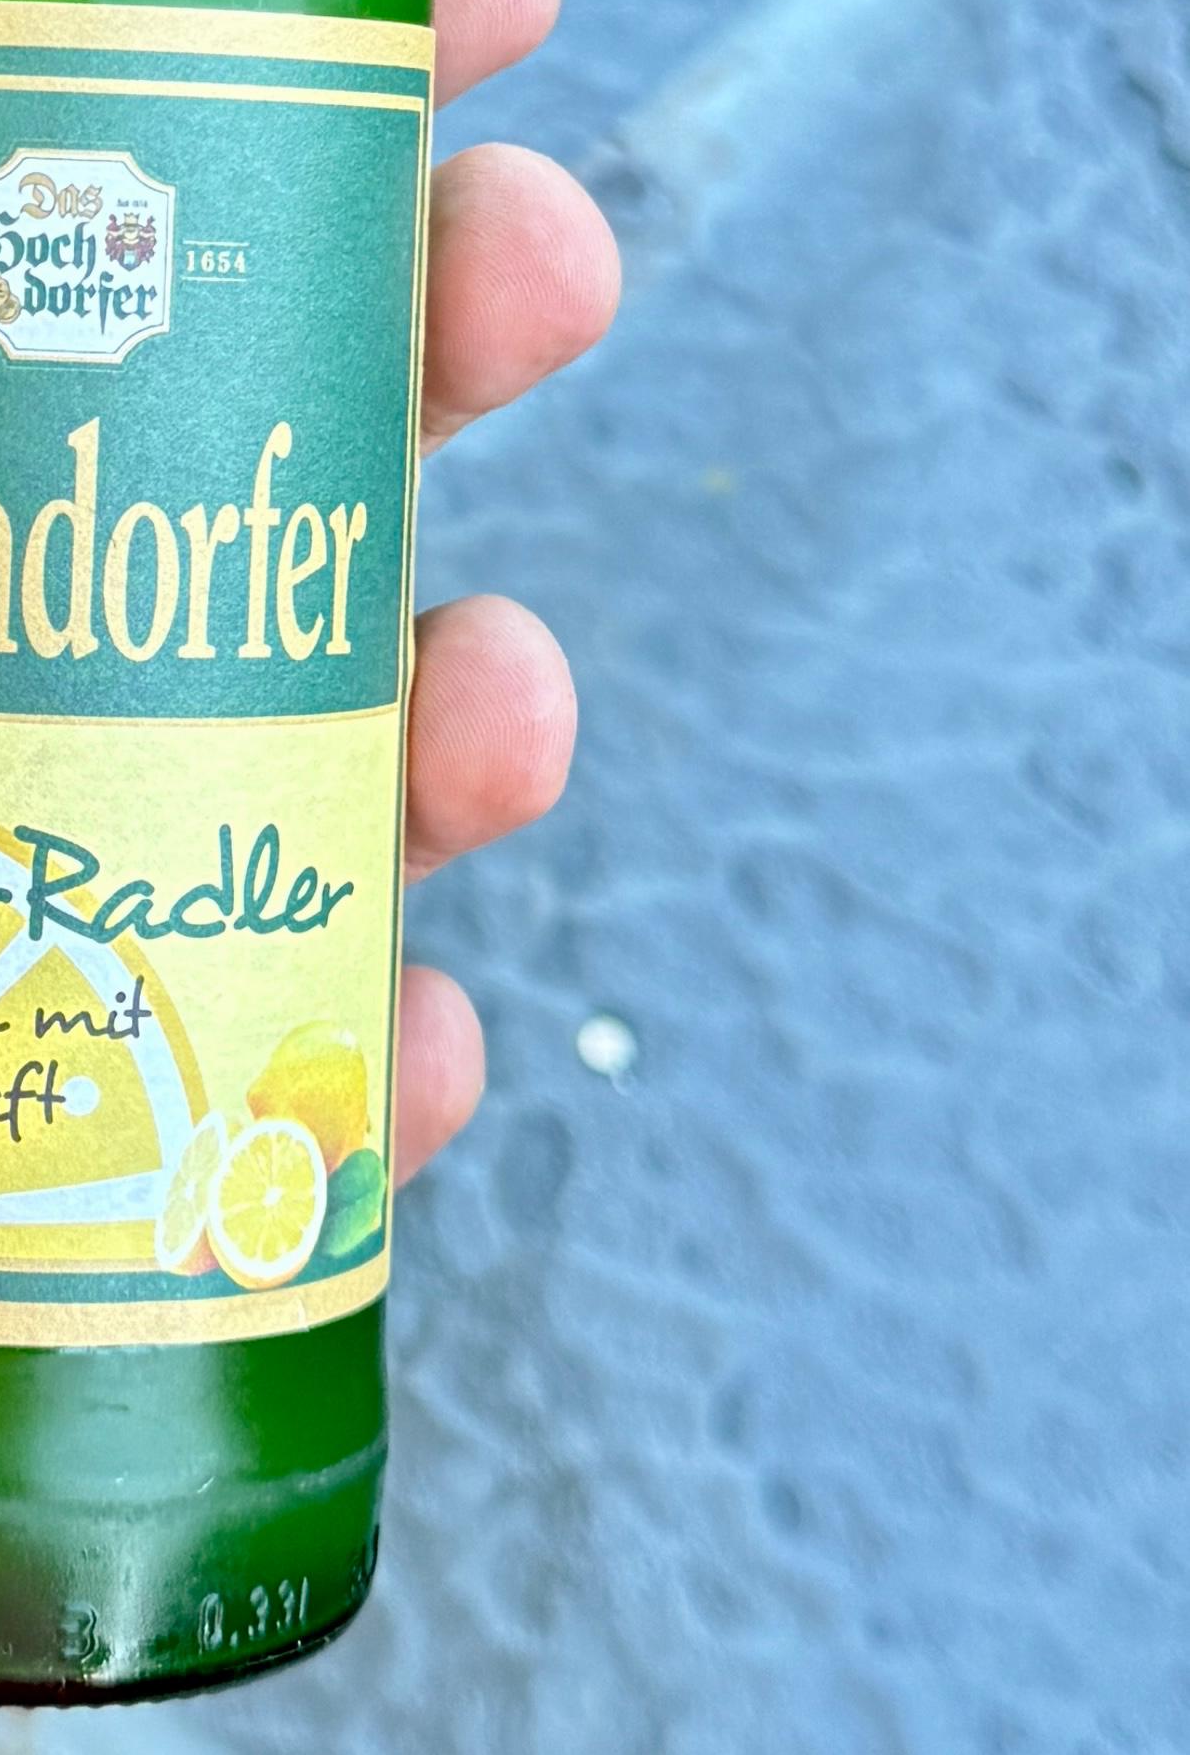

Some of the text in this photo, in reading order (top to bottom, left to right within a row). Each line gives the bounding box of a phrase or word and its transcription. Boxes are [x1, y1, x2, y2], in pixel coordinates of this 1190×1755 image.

[18, 172, 103, 220] Das
[186, 250, 246, 274] 1654
[21, 268, 158, 335] dorfer
[34, 976, 152, 1040] mit
